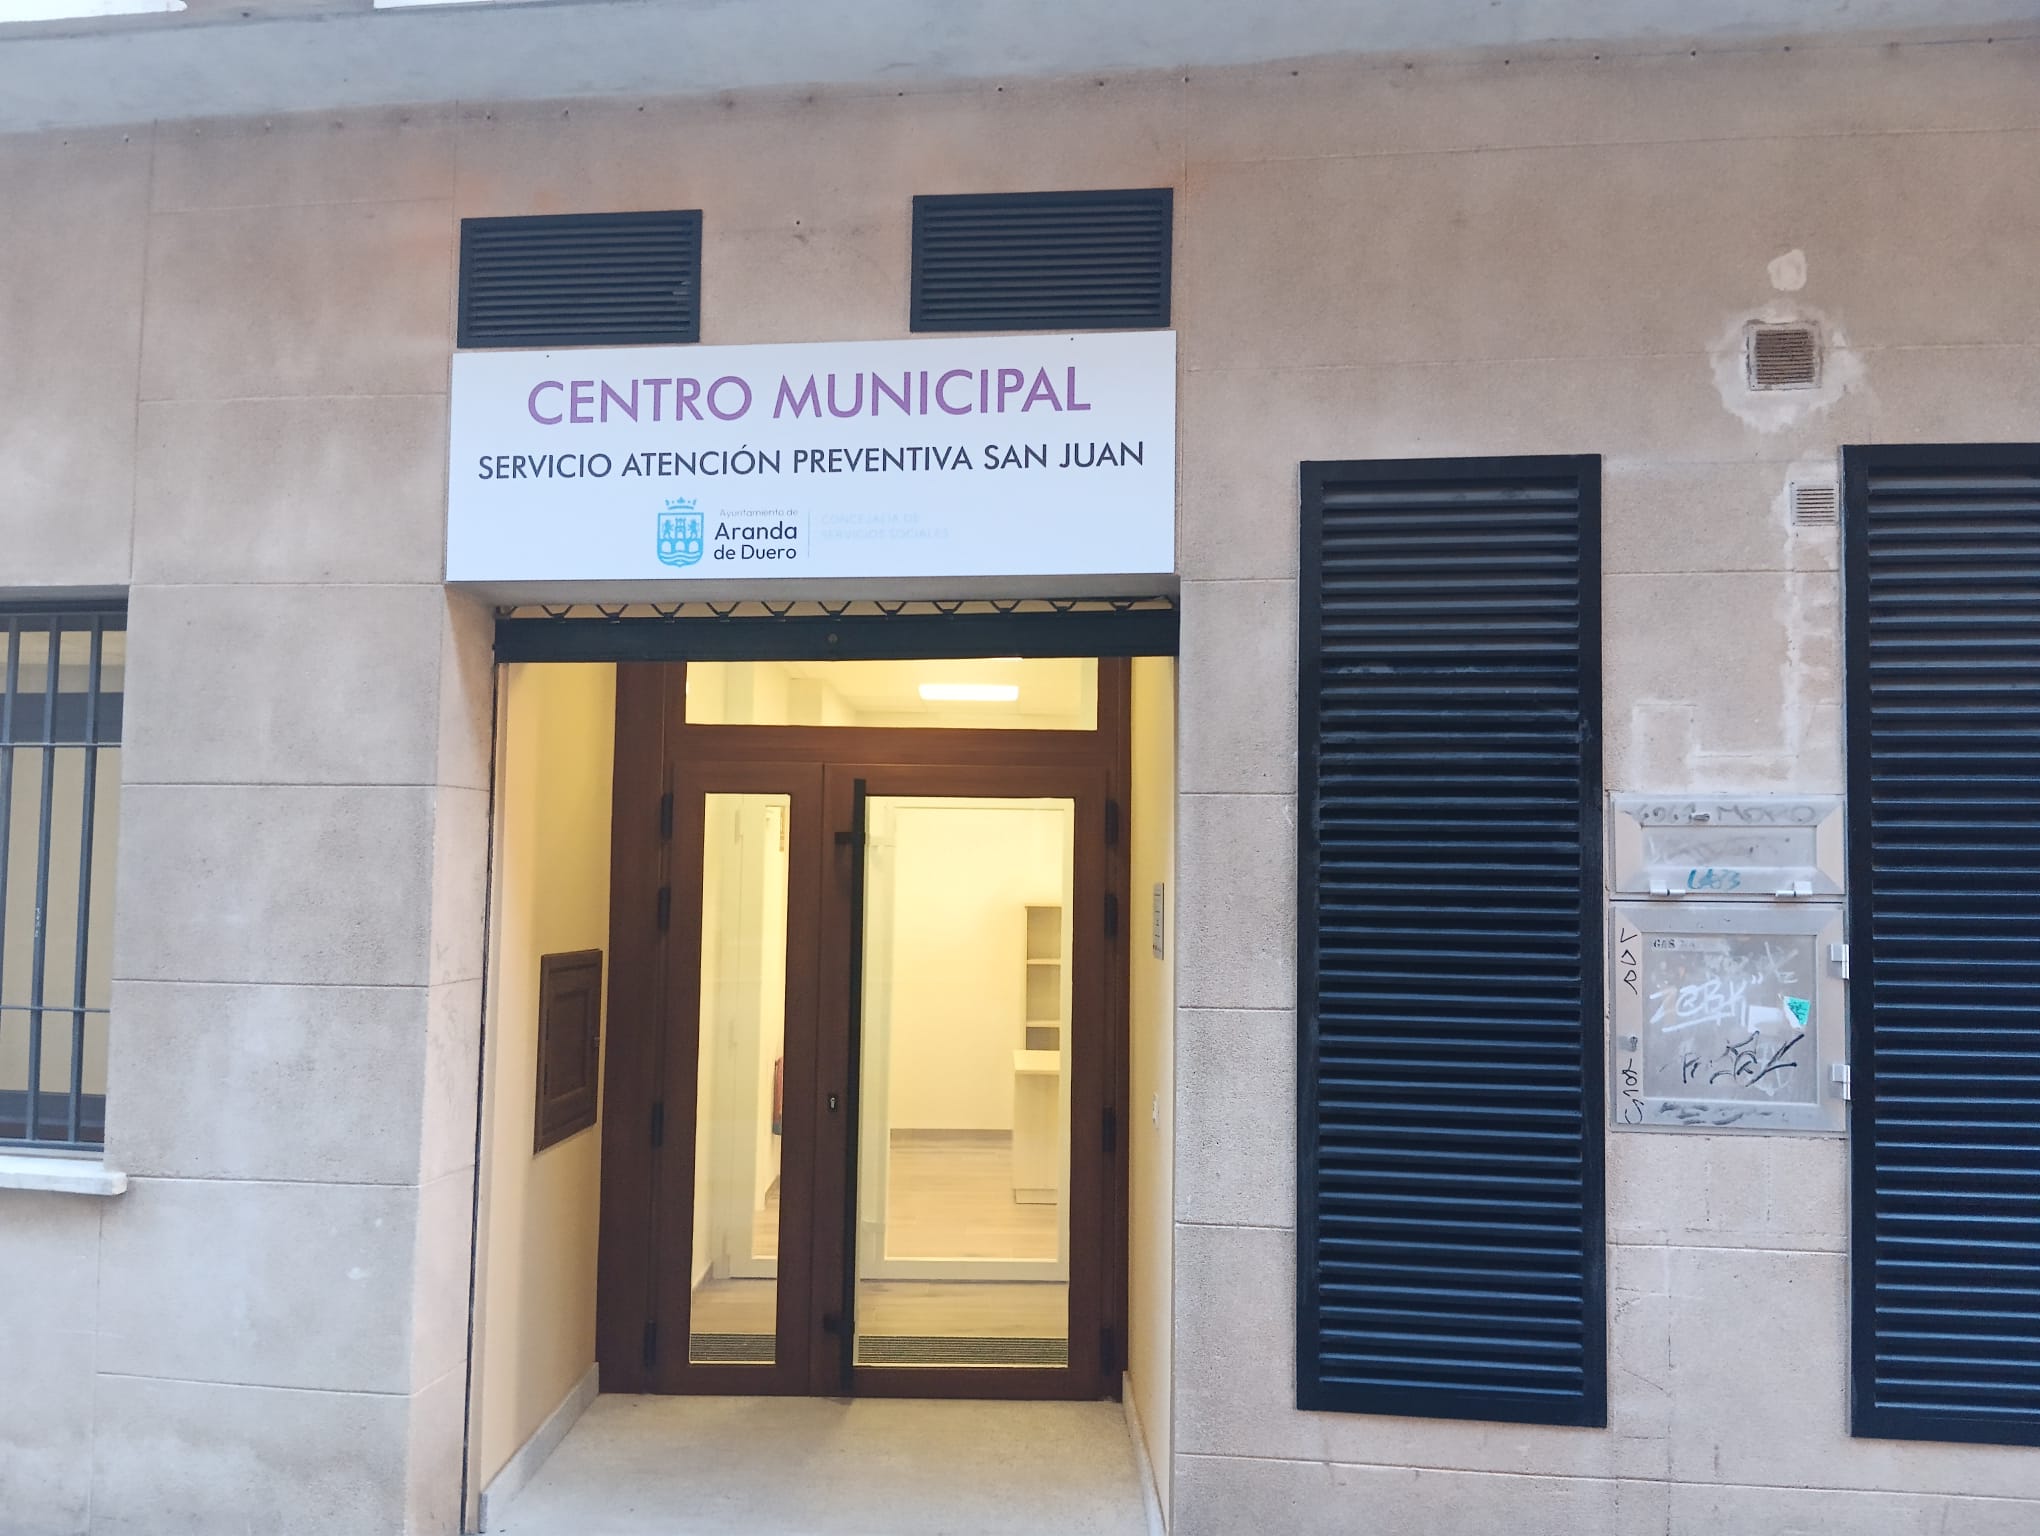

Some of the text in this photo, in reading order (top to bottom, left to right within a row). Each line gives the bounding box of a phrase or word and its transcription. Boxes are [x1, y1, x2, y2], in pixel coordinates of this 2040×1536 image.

[528, 366, 1092, 426] CENTRO MUNICIPAL
[478, 441, 1144, 480] SERVICIO ATENCIÓN PREVENTIVA SAN JUAN
[720, 508, 798, 518] Ayuntamiento de
[903, 511, 920, 524] DE
[714, 520, 798, 541] Aranda
[713, 543, 797, 560] de Duero
